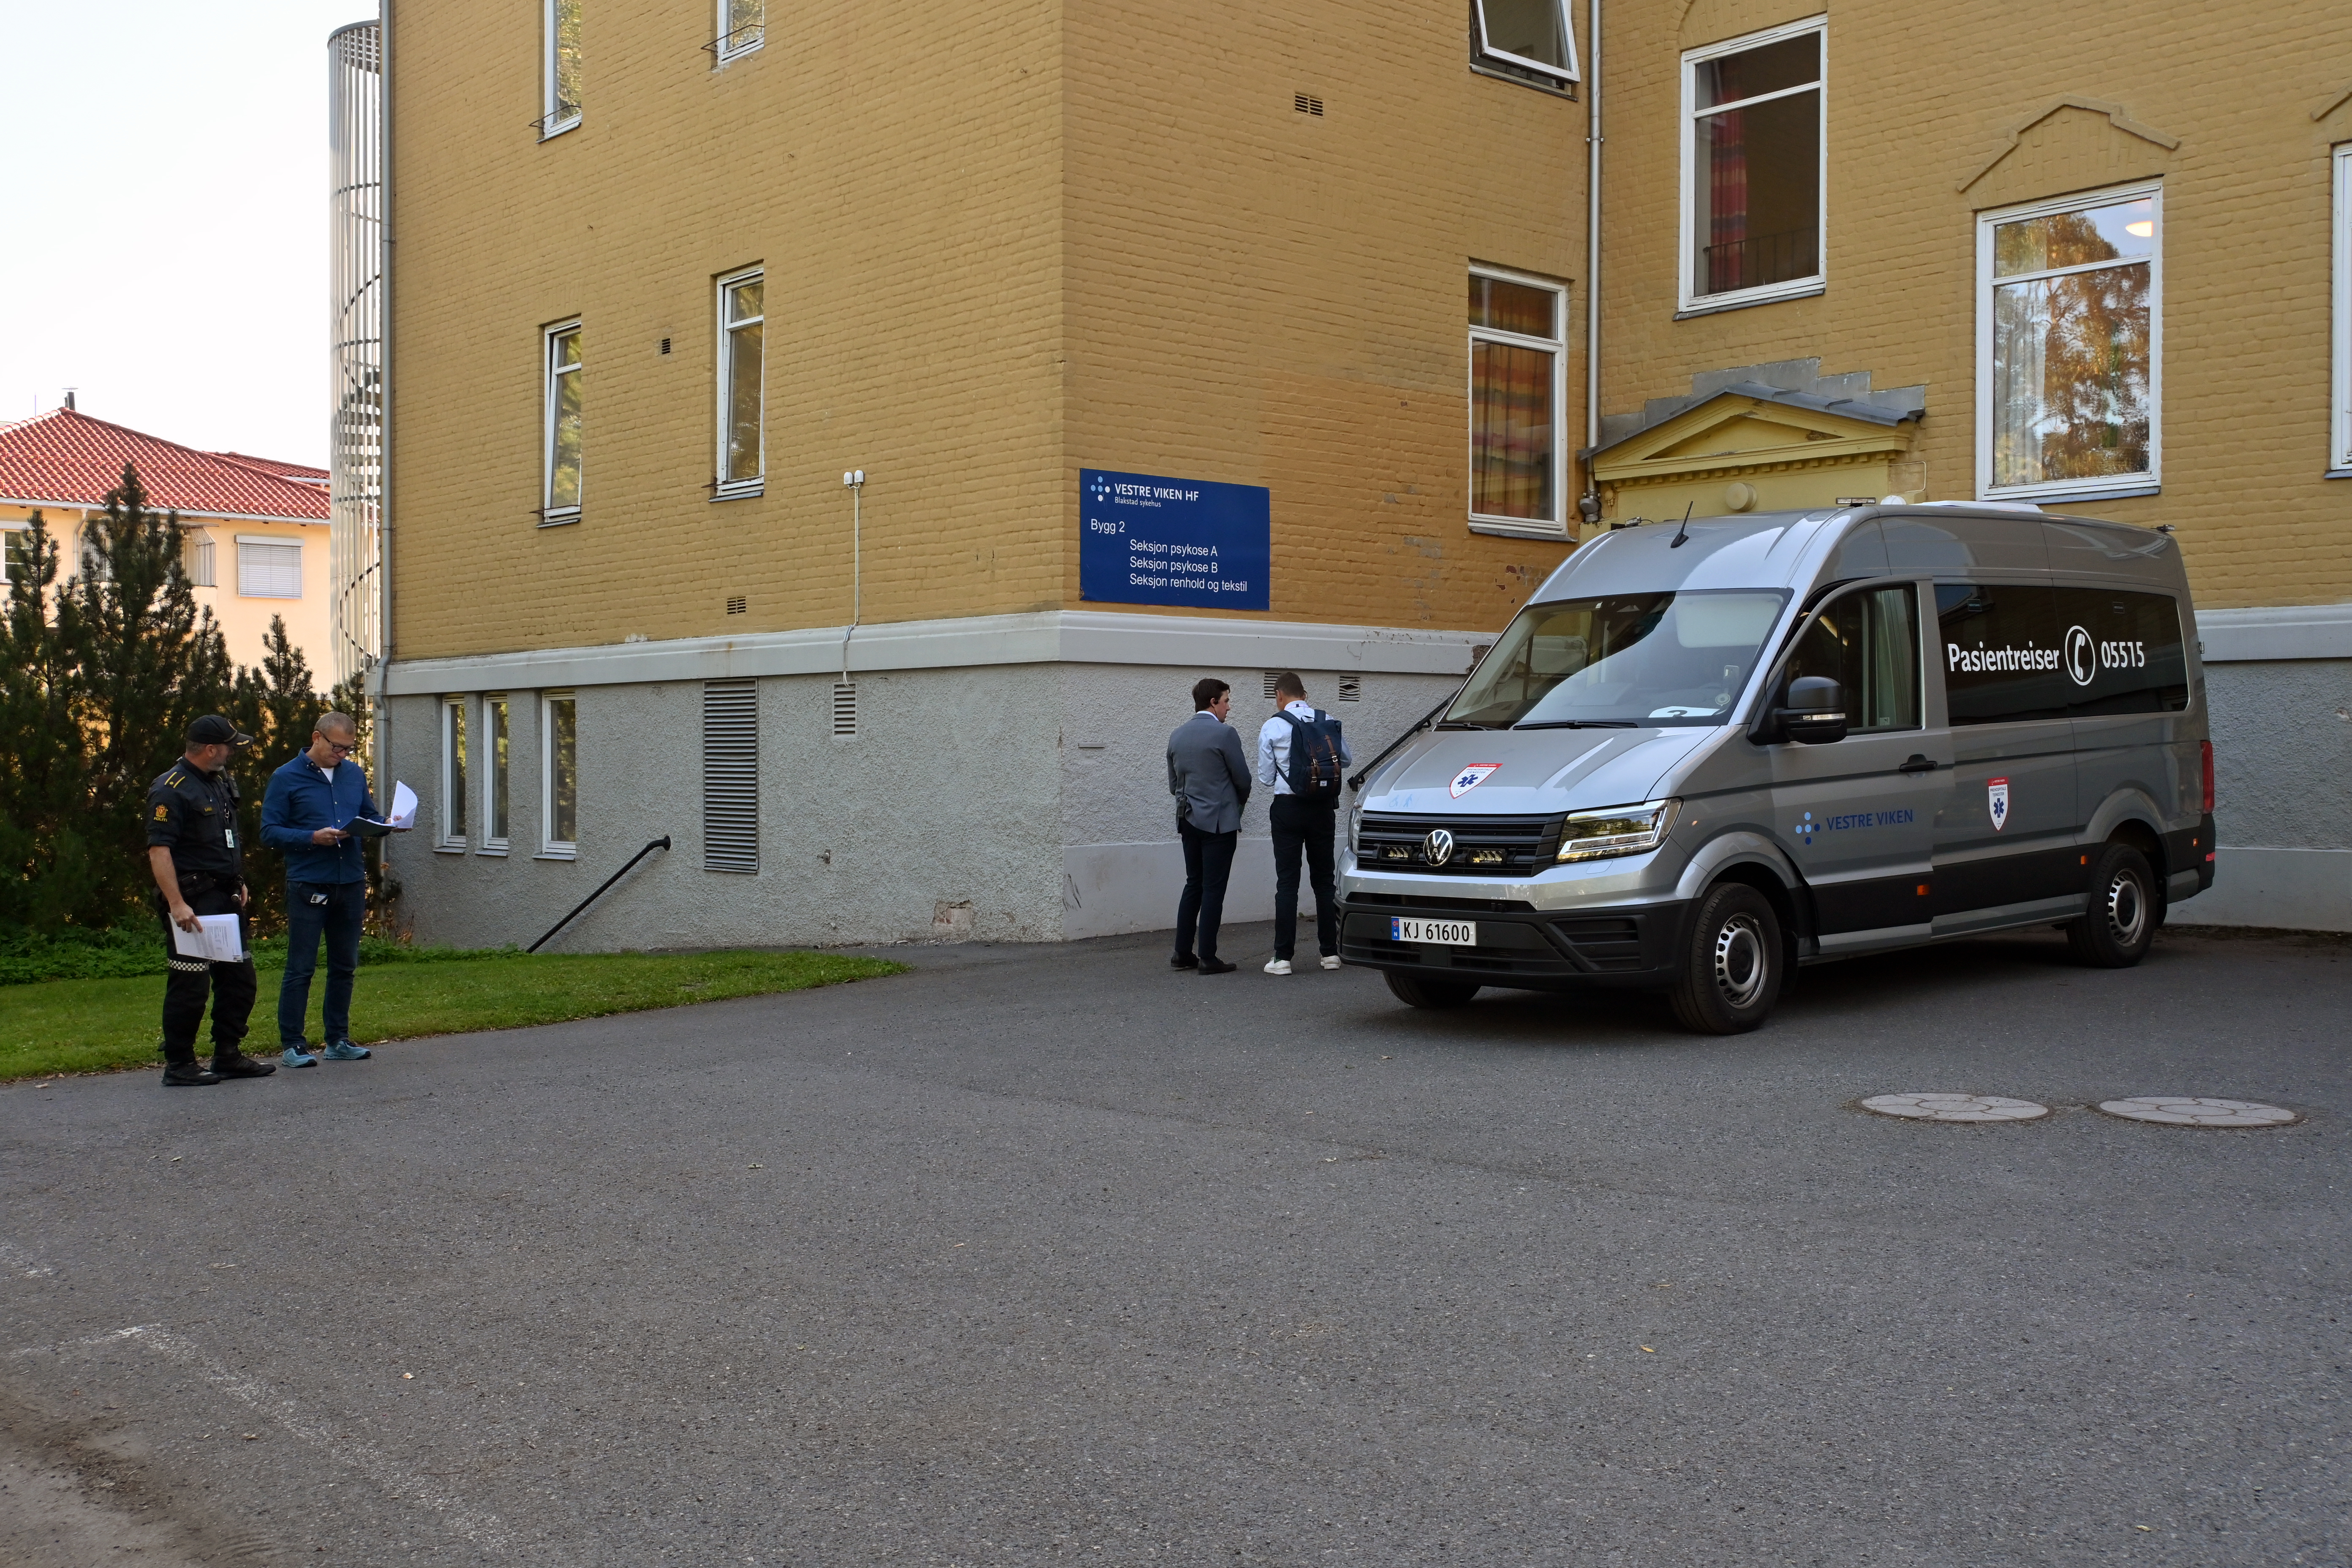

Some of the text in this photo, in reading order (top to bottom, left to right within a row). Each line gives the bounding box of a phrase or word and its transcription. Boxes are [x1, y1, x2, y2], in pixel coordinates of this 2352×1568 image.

[1115, 484, 1199, 501] VESTRE VIKEN HF
[1115, 496, 1161, 507] Blakstad sykehus
[1091, 518, 1125, 534] Bygg 2
[1130, 539, 1218, 557] Seksjon psykose A
[1130, 556, 1218, 574] Seksjon psykose B
[1130, 573, 1247, 593] Seksjon renhold og tekstil
[1948, 640, 2145, 672] Pasientreiser 05515
[1827, 809, 1913, 830] VESTRE VIKEN
[1404, 922, 1470, 942] KJ 61600
